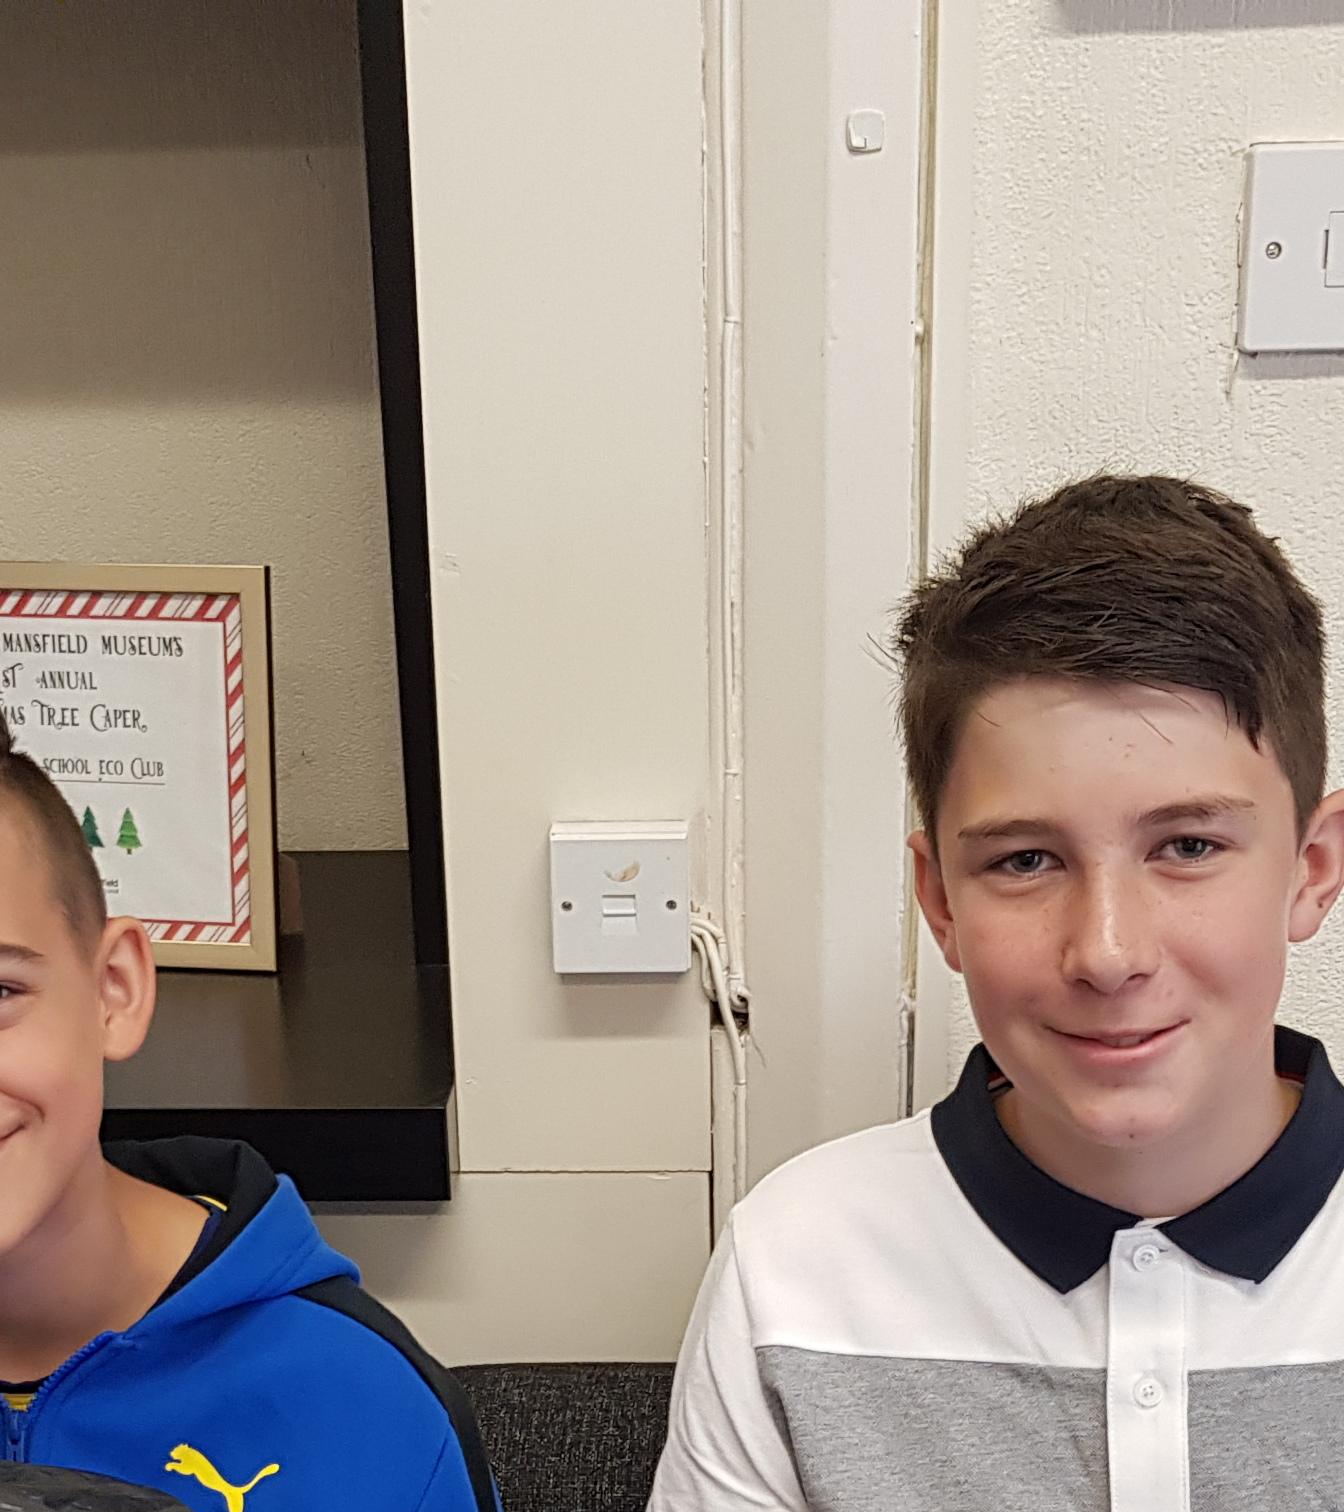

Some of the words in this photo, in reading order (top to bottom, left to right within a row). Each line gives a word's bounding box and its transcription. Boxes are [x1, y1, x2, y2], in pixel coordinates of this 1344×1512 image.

[2, 632, 88, 655] MANSFIELD
[36, 670, 98, 690] ANNUAL
[31, 699, 80, 730] TREE
[90, 704, 148, 733] CAPER
[42, 757, 91, 775] SCHOOL
[99, 760, 123, 776] ECO
[131, 757, 164, 780] CLUB
